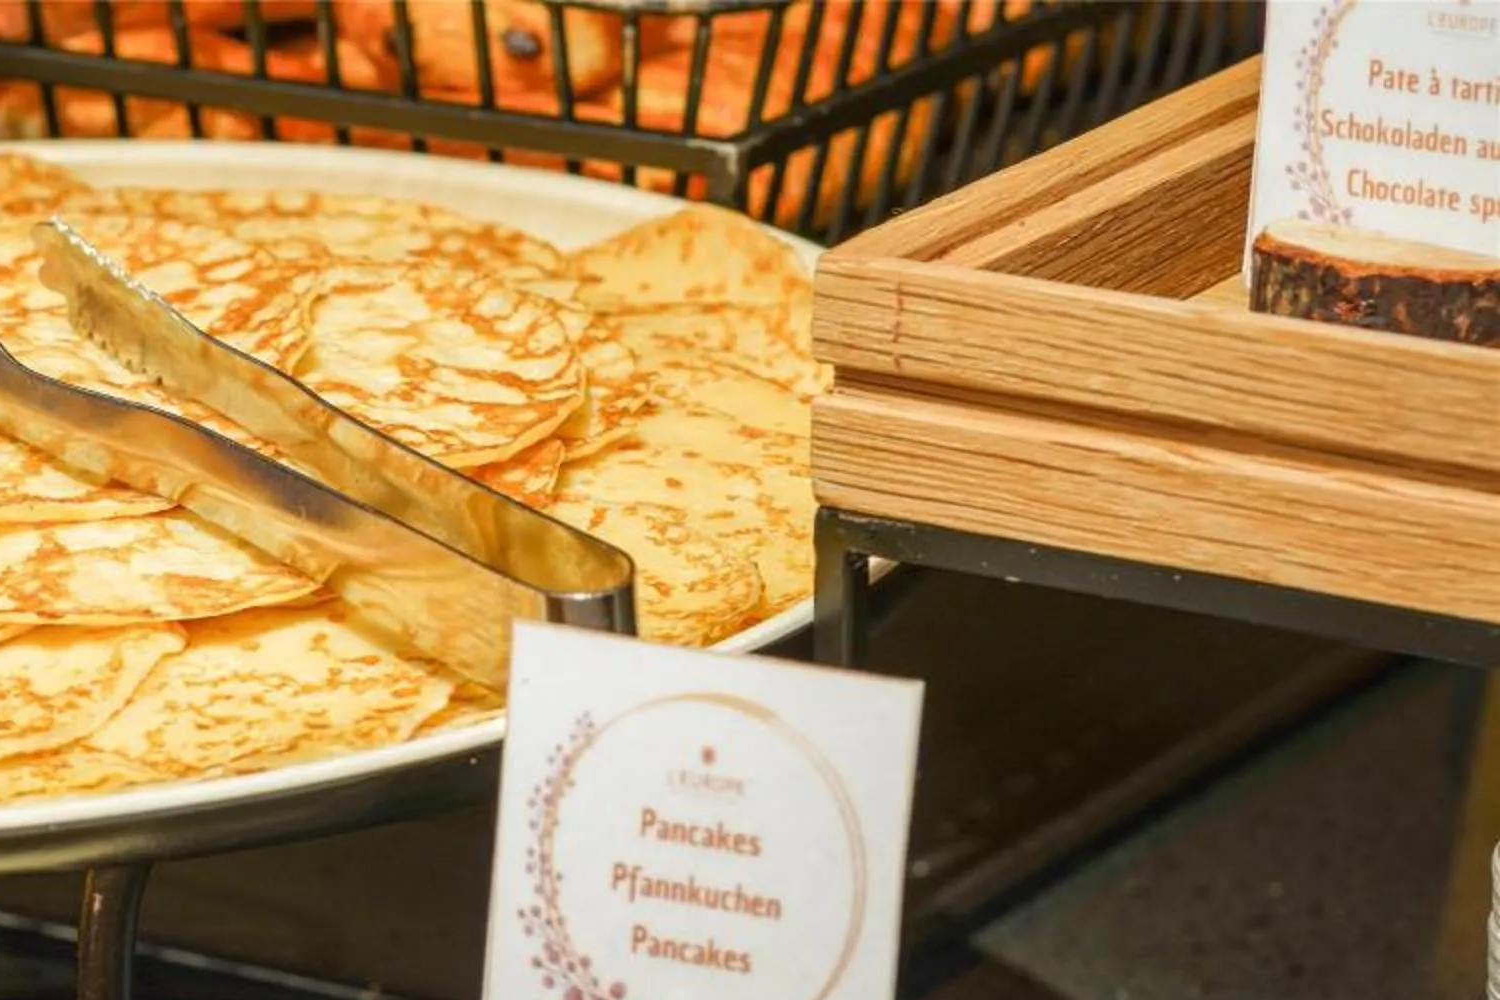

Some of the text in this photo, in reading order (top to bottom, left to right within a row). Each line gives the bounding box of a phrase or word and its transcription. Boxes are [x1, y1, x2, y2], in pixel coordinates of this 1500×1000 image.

[1368, 58, 1420, 94] Pate
[1428, 67, 1441, 96] à
[1320, 108, 1467, 157] Schokoladen
[1346, 168, 1460, 212] Chocolate
[640, 807, 762, 857] Pancakes
[611, 862, 783, 921] Pfannkuchen
[631, 924, 753, 975] Pancakes
